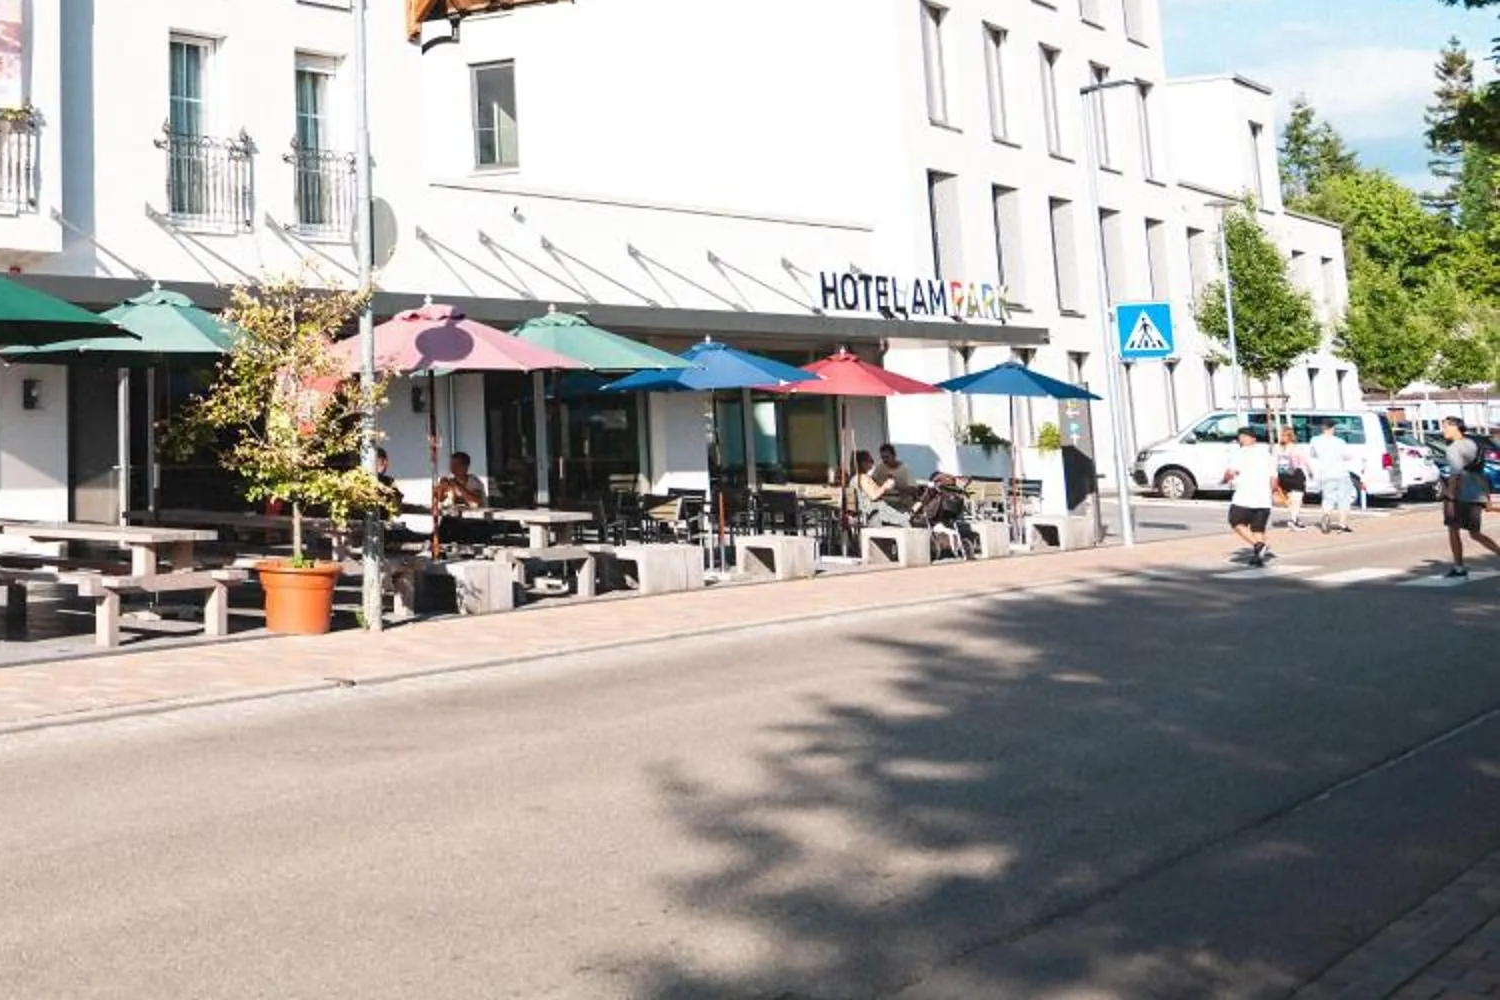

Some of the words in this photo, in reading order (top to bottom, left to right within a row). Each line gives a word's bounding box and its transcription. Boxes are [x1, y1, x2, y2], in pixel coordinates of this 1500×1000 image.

[819, 271, 907, 313] HOTEL
[911, 277, 948, 316] AM
[950, 281, 1011, 320] PARK
